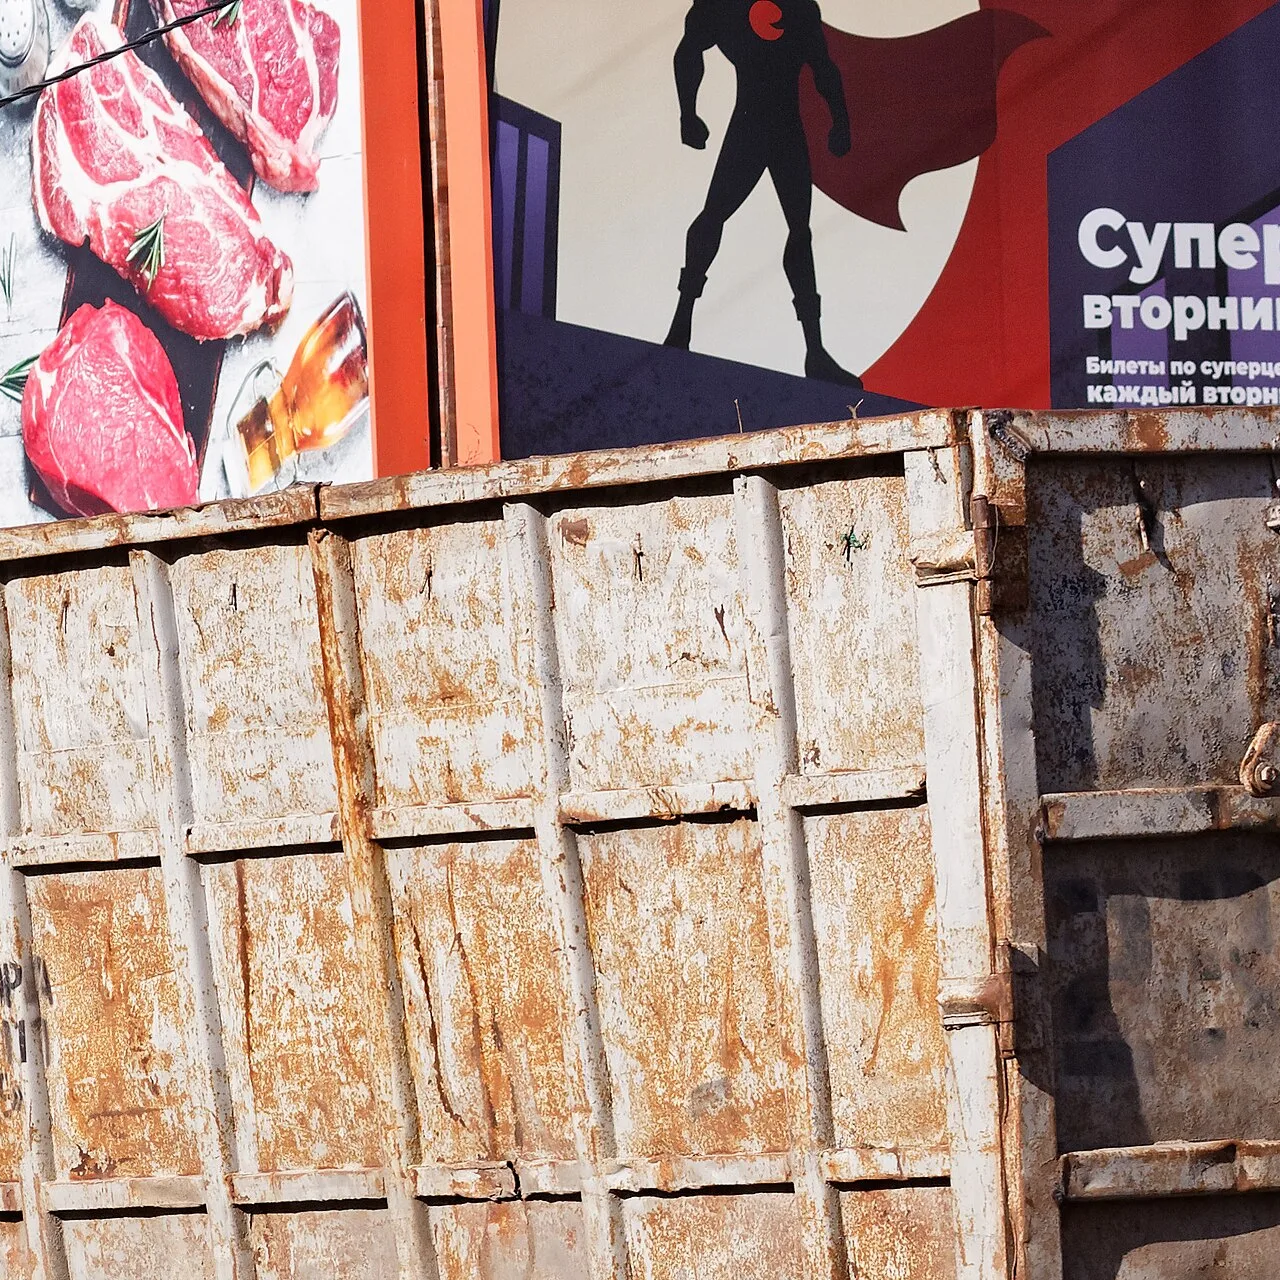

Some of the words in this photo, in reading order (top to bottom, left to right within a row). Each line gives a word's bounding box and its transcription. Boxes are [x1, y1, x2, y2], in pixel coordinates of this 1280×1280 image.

[1085, 356, 1166, 375] Билеты
[1170, 360, 1196, 376] по
[1087, 380, 1196, 407] каждый
